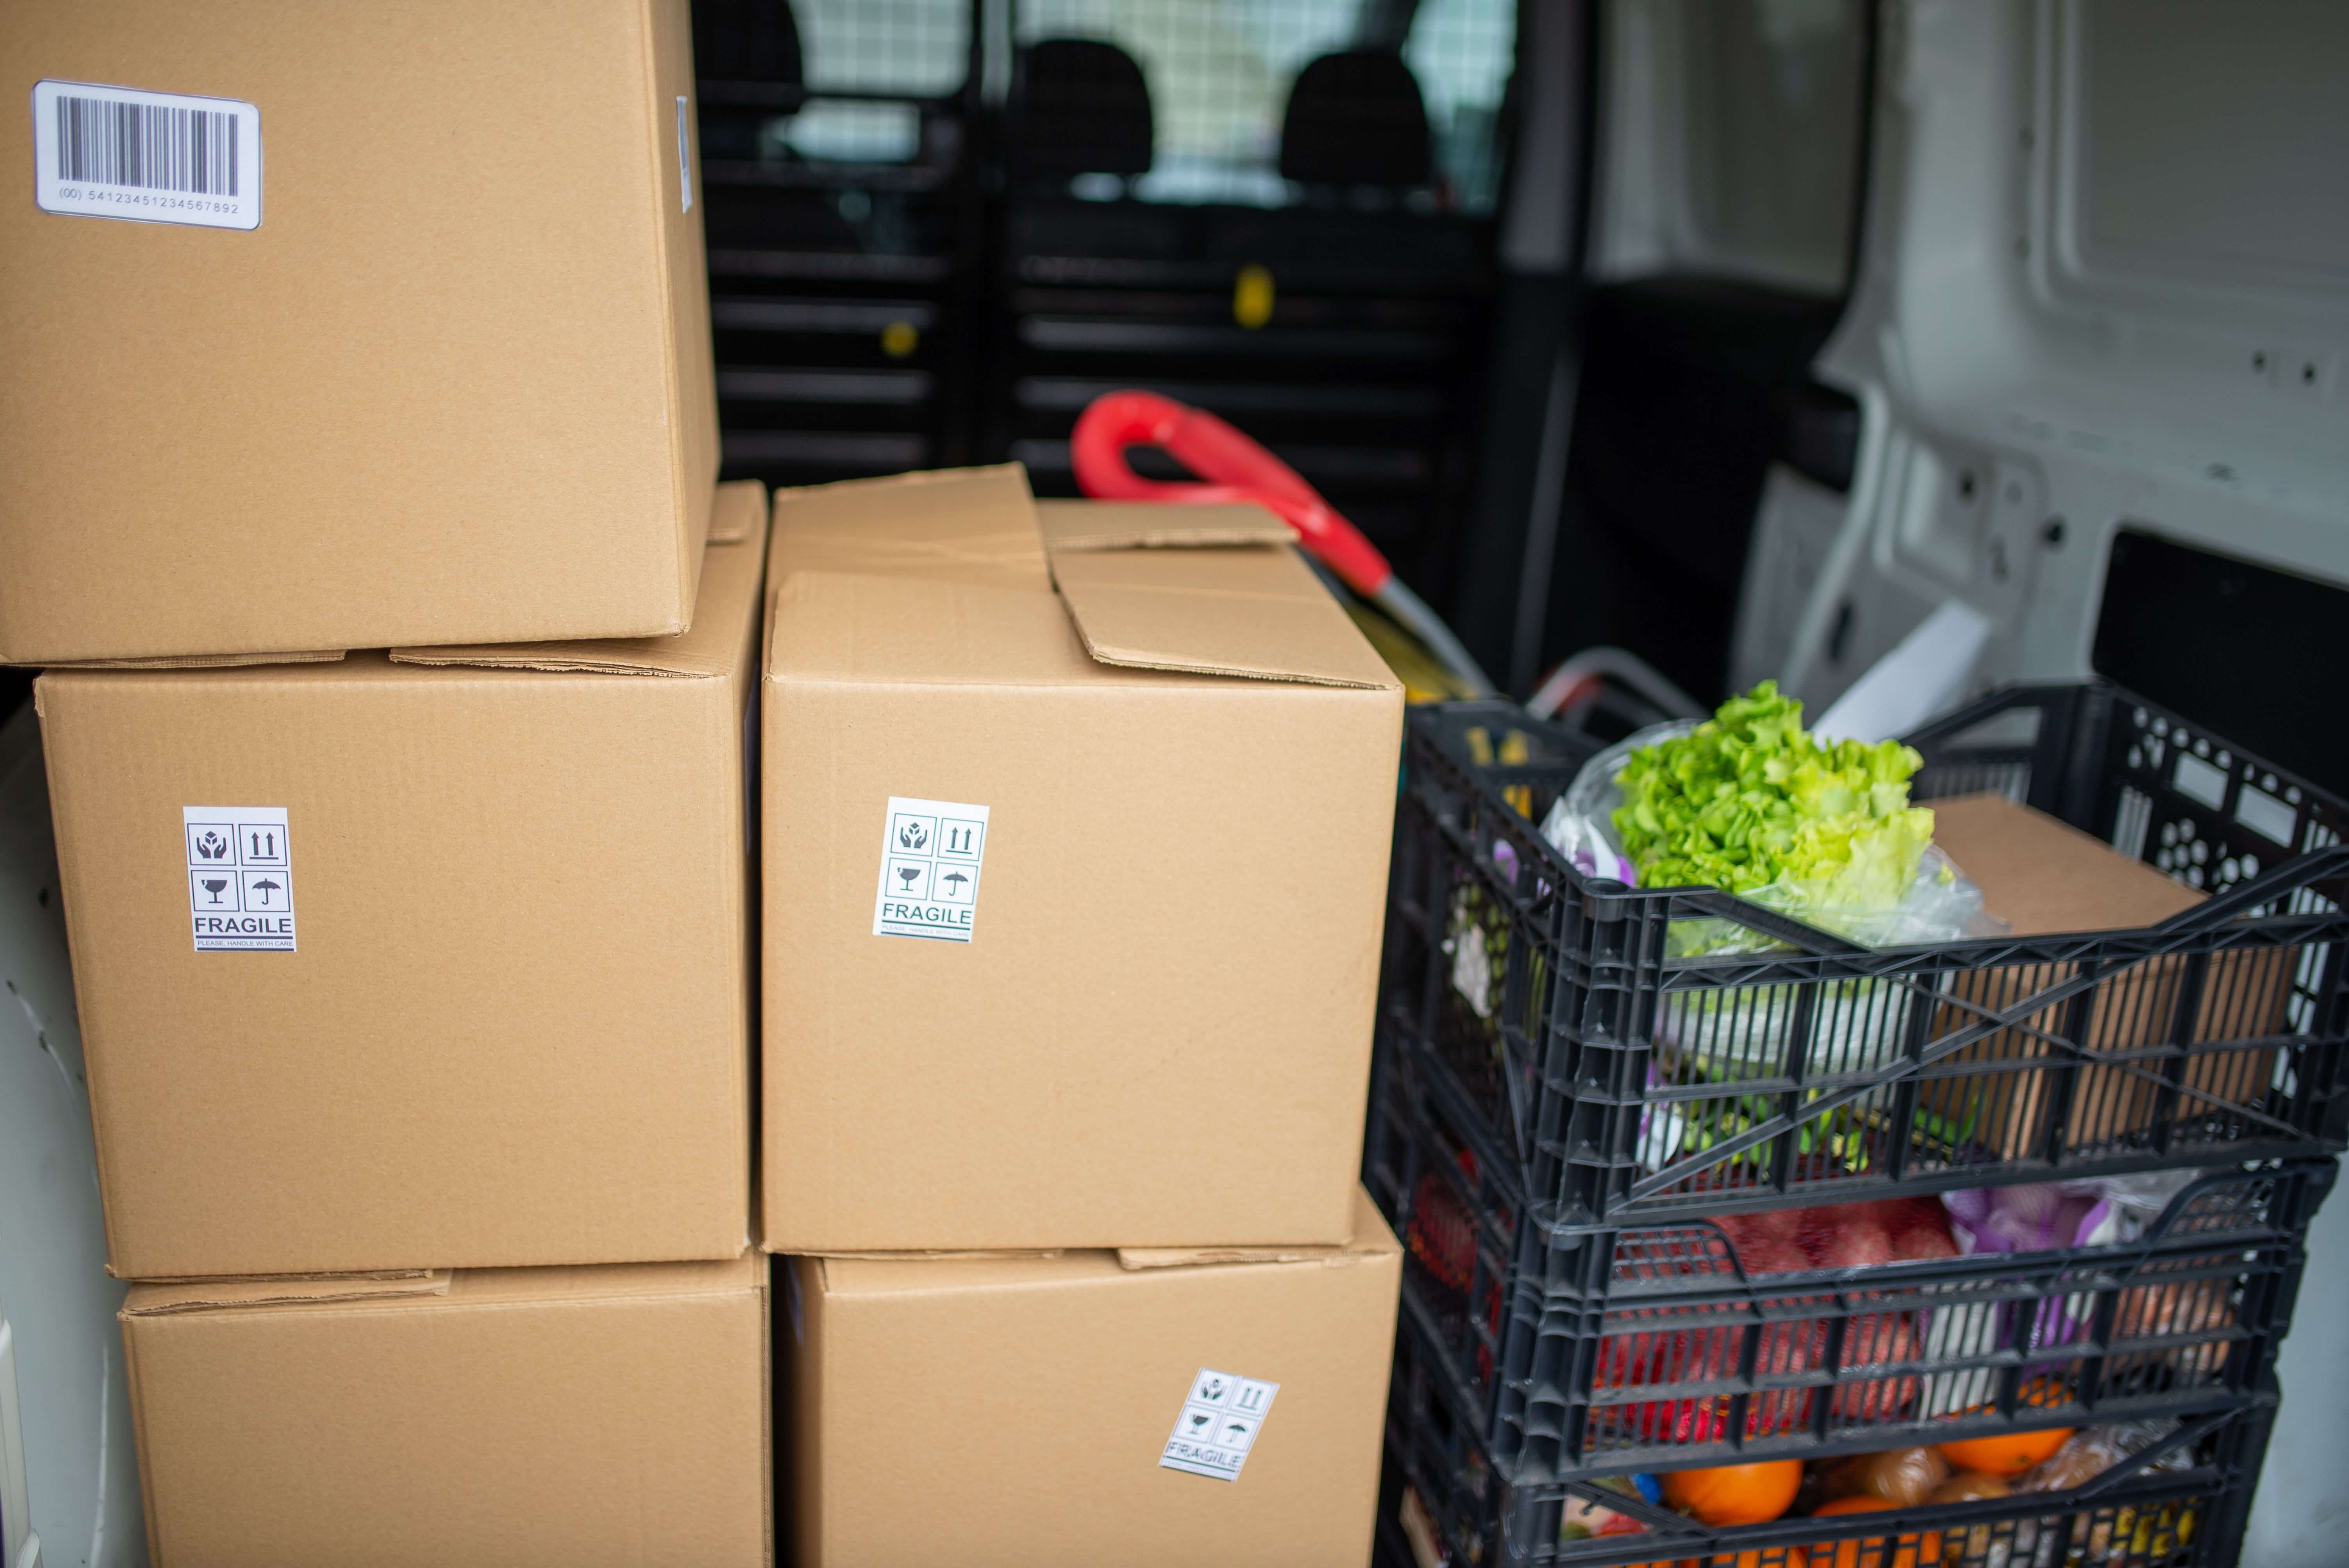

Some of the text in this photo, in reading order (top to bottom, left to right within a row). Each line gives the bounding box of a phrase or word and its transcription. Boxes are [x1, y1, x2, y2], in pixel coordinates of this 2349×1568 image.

[59, 187, 238, 214] (00) 54123451234567892
[195, 917, 292, 933] FRAGILE
[882, 903, 971, 925] FRAGILE
[1169, 1442, 1241, 1468] FRAGILE
